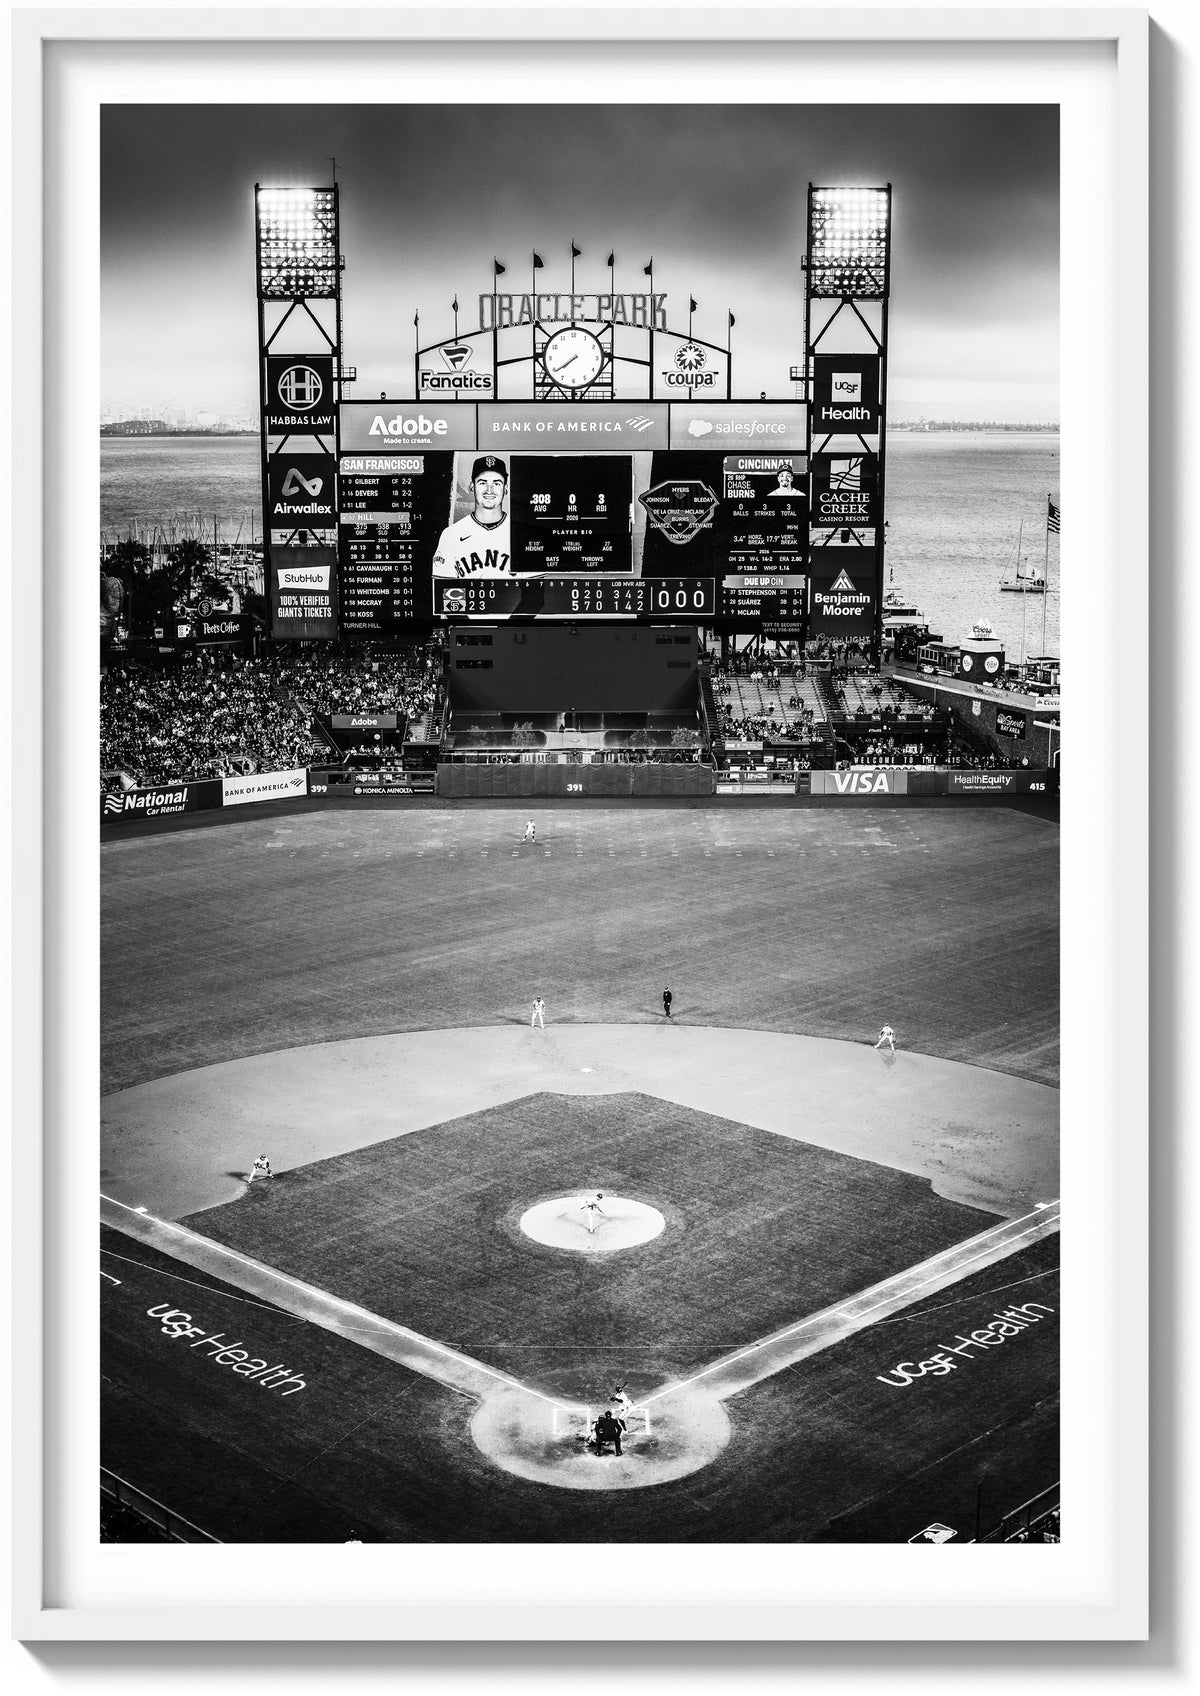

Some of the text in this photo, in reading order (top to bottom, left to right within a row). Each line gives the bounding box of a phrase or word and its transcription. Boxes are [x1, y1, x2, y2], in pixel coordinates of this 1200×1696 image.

[479, 293, 668, 333] ORACLE PARK
[421, 371, 492, 388] Fanatics
[667, 373, 714, 392] coupa
[835, 382, 858, 394] UCSF
[822, 407, 870, 420] Health
[270, 416, 331, 425] HABBAS LAW
[368, 415, 448, 435] Adobe
[493, 422, 622, 432] BANK OF AMERICA
[715, 420, 786, 437] salesforce
[344, 459, 420, 470] SAN FRANCISCO
[402, 477, 412, 485] 2-2
[727, 481, 751, 489] CHASE
[530, 494, 551, 505] .308
[569, 494, 576, 505] 0
[598, 494, 605, 505] 3
[728, 490, 755, 498] BURNS
[820, 493, 870, 503] CACHE
[274, 503, 331, 514] Airwallex
[403, 501, 413, 509] 1-2
[821, 504, 868, 514] CREEK
[357, 513, 374, 521] HILL
[284, 574, 323, 584] StubHub
[468, 589, 644, 600] 0 0 0 0 2 0 3 4 2
[658, 591, 704, 608] 0 0 0
[815, 592, 871, 606] Benjamin
[279, 595, 330, 606] 100% VERIFIED
[469, 601, 644, 611] 2 3 5 7 0 1 4 2
[278, 607, 332, 619] GIANTS TICKETS
[221, 621, 240, 634] Coffee
[845, 636, 871, 644] LIGHT
[350, 718, 378, 726] Adobe
[854, 756, 896, 764] WELCOME
[903, 756, 914, 764] TO
[829, 772, 889, 793] VISA
[954, 775, 1013, 786] HealthEquity
[224, 782, 289, 798] BANK OF AMERICA
[310, 785, 328, 793] 399
[566, 783, 582, 792] 391
[1029, 782, 1046, 791] 415
[124, 788, 189, 811] National
[146, 803, 185, 818] Car Rental
[146, 1303, 306, 1395] UCSF Health
[876, 1302, 1055, 1387] UCSF Health
